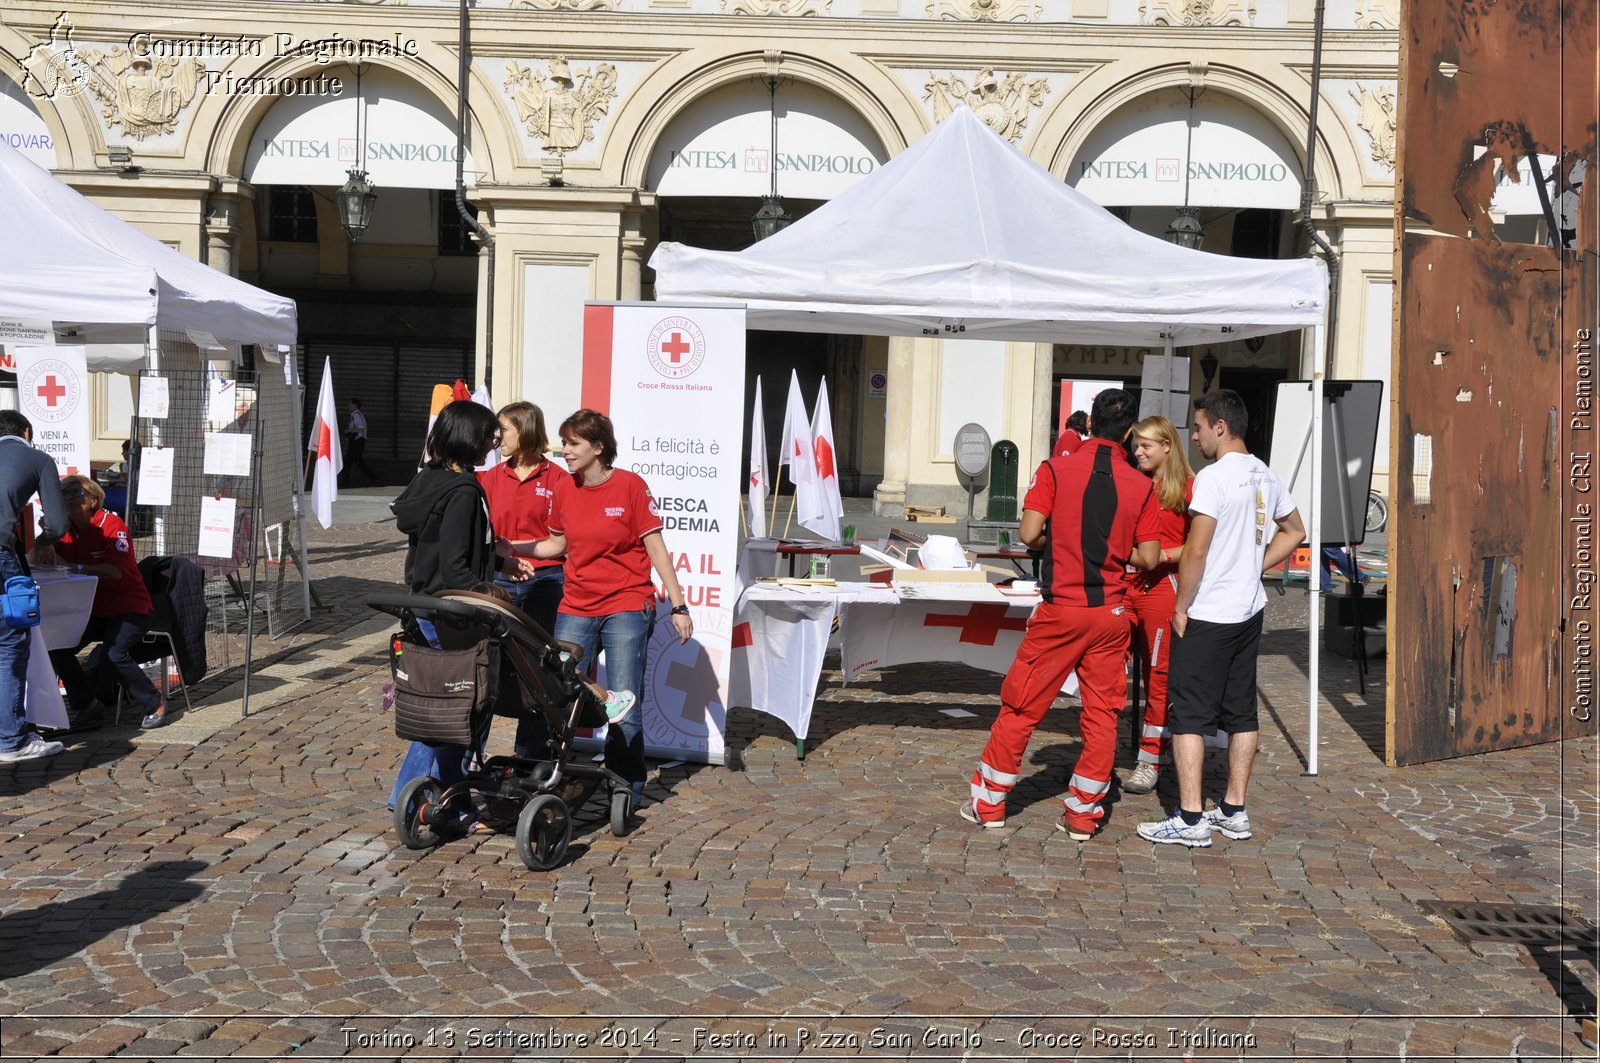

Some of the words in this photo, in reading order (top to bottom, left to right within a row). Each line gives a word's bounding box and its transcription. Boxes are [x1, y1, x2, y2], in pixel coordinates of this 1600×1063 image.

[0, 133, 54, 149] NOVAR
[263, 139, 331, 158] INTESA
[670, 151, 737, 169] INTESA
[774, 153, 874, 175] SANPAOLO
[1081, 161, 1148, 179] INTESA
[1186, 161, 1287, 182] SANPAOLO
[1053, 346, 1151, 365] YMPIC
[660, 383, 684, 391] Rossa
[40, 430, 60, 440] VIENI
[63, 430, 68, 440] A
[632, 436, 650, 451] La
[656, 437, 704, 454] felicità
[710, 439, 720, 454] è
[631, 462, 718, 481] contagiosa
[700, 554, 721, 575] IL
[853, 659, 878, 672] TORINO
